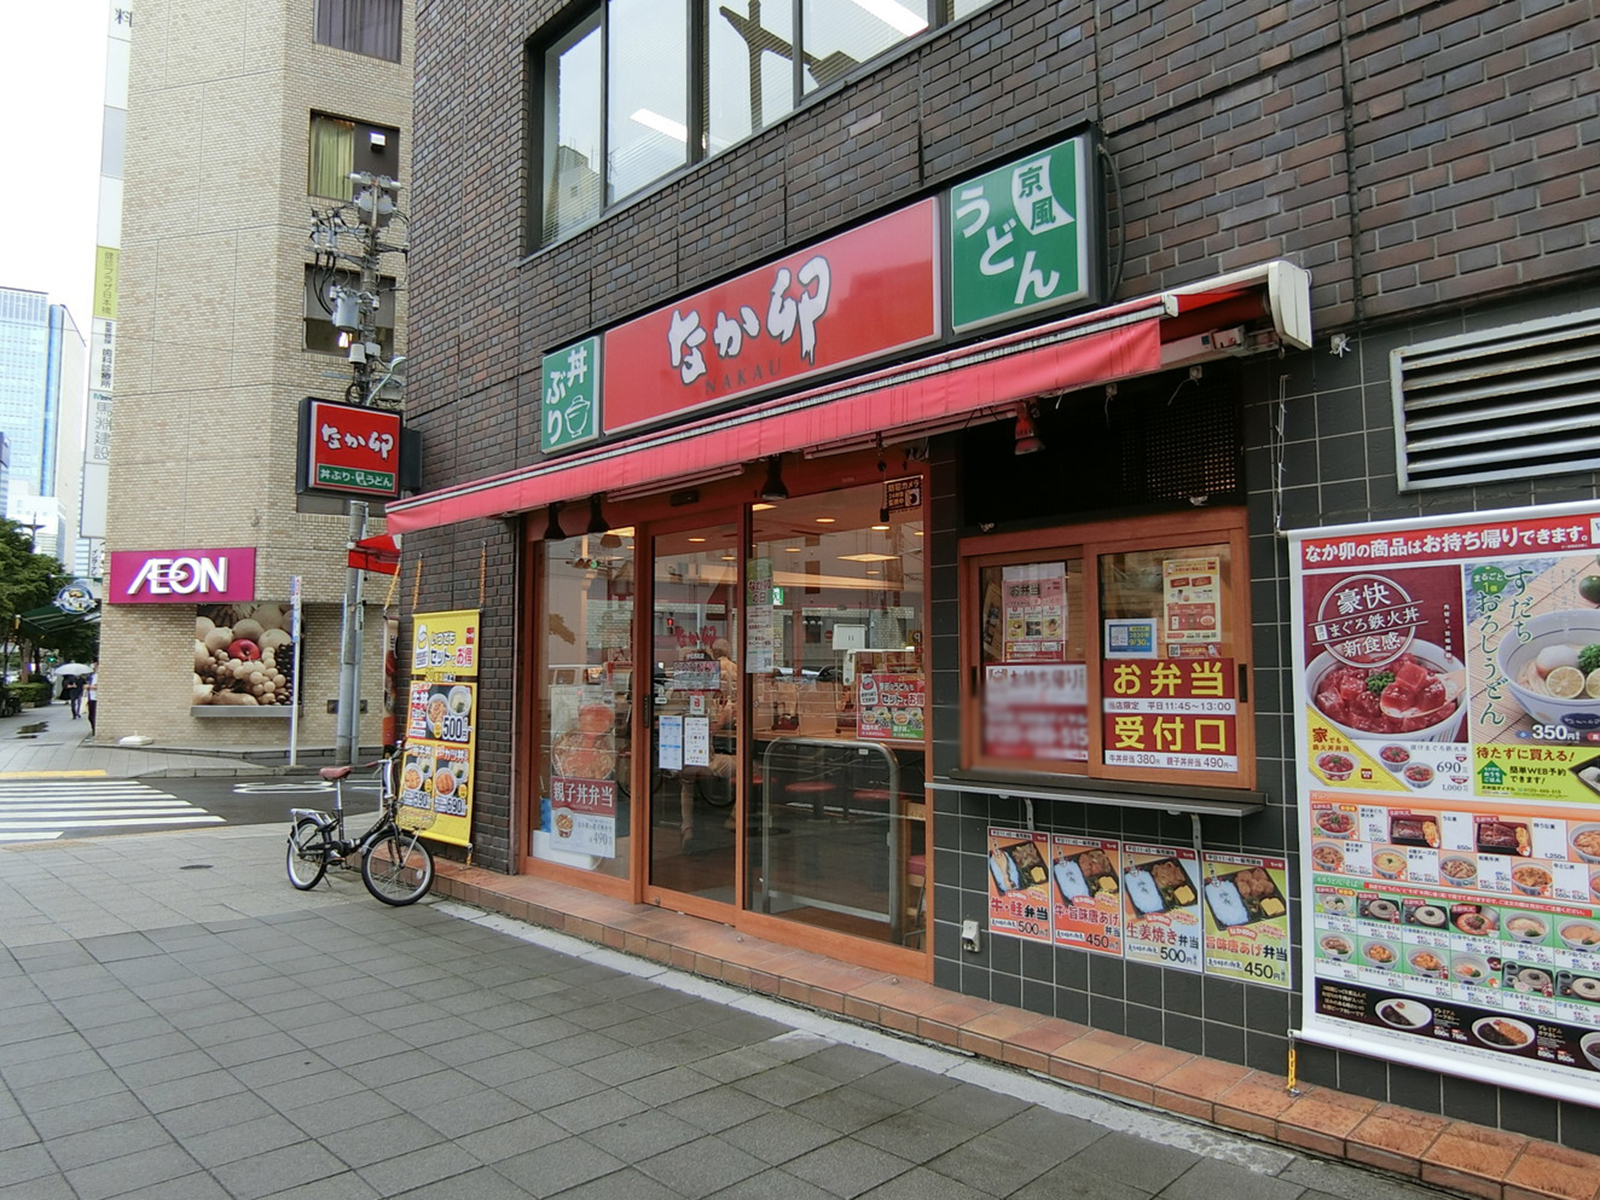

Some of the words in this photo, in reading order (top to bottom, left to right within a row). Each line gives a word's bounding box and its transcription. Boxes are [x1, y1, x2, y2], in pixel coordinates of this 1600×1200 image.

[1018, 163, 1056, 230] 京風
[956, 185, 1060, 304] うどん
[667, 255, 831, 386] なか卯
[101, 349, 113, 389] 歯科診療所
[705, 358, 781, 396] NAKAU
[546, 346, 588, 445] 丼ぶり
[321, 423, 394, 459] なか卯
[1305, 526, 1588, 563] なか卯の商品はお持ち帰りできます。
[1474, 572, 1504, 582] まるごと
[1335, 582, 1391, 615] 豪快
[1505, 566, 1533, 643] すだち
[1328, 606, 1420, 638] まぐろ鉄火丼
[1343, 632, 1401, 657] 新食感
[1475, 591, 1509, 725] おろしうどん
[1113, 661, 1223, 696] お弁当
[1115, 716, 1226, 752] 受付口
[1312, 727, 1342, 744] 家でも
[1509, 766, 1567, 777] 簡単WEB予約
[553, 781, 613, 807] 親子丼弁当
[991, 898, 1048, 920] 牛・鮭弁当
[1055, 904, 1119, 926] 牛・旨味唐あげ
[1105, 926, 1120, 937] 弁当
[1126, 923, 1199, 949] 生姜焼き弁当
[1206, 936, 1288, 962] 旨味唐あげ弁当
[1433, 1007, 1455, 1016] プレミアム
[1538, 1024, 1562, 1034] プレミアム
